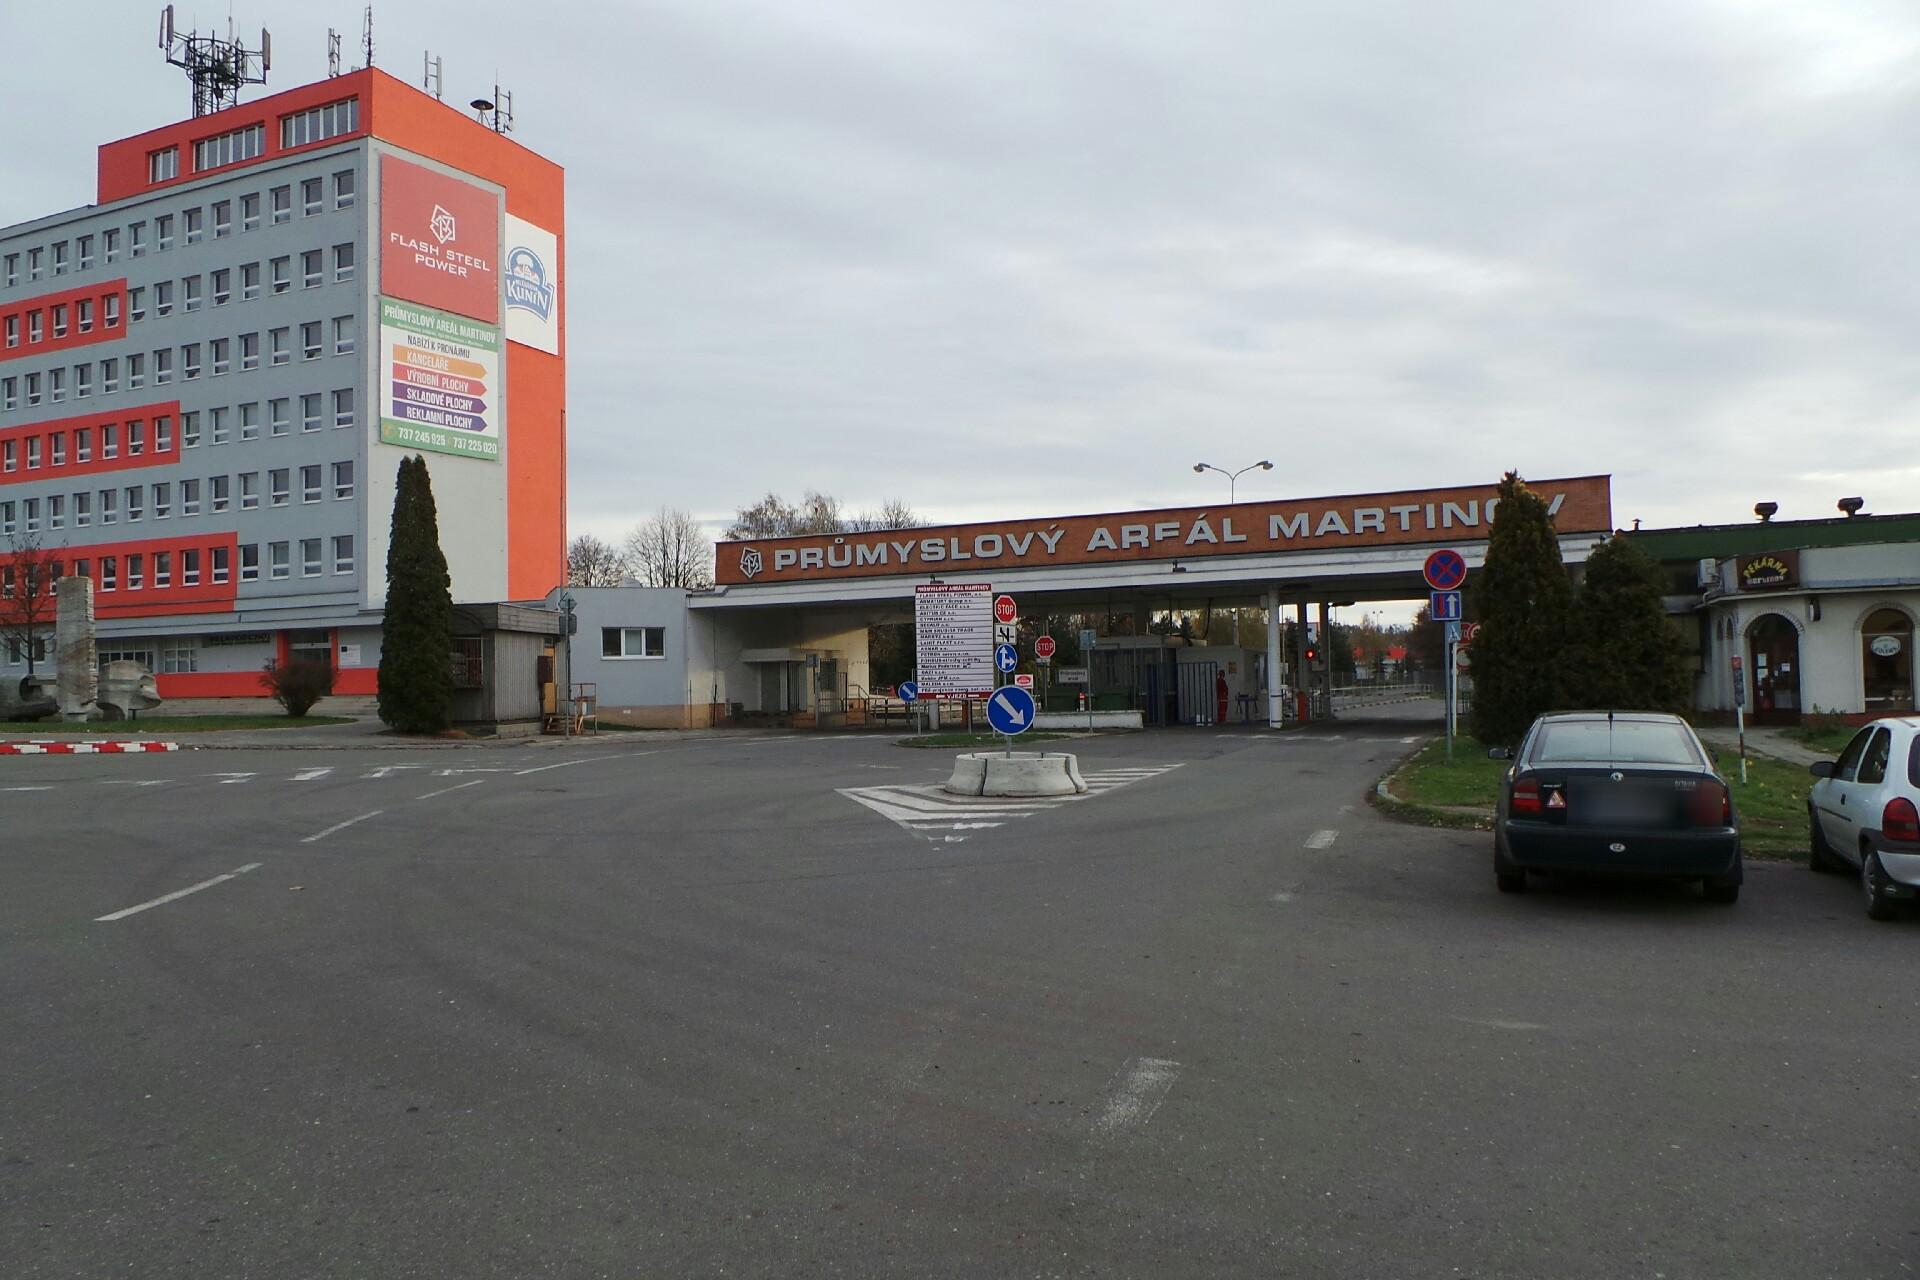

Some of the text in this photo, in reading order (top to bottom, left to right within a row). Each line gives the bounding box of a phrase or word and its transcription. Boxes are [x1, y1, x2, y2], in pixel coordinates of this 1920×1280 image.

[390, 232, 490, 272] FLASH STEEL
[415, 253, 468, 278] POWER
[384, 305, 435, 329] PRŮMYSLOVÝ
[436, 319, 459, 335] AREÁL
[460, 325, 496, 343] MARTINOV
[407, 334, 430, 350] NABÍZÍ
[431, 341, 436, 350] K
[406, 369, 469, 393] VÝROBNÍ PLOCHY
[406, 388, 473, 411] SKLADOVÉ PLOCHY
[406, 406, 473, 429] REKLAMNÍ PLOCHY
[398, 427, 413, 440] 737
[453, 437, 467, 450] 737
[774, 524, 1065, 571] PRŮMYSLOVÝ
[1269, 493, 1565, 539] MARTIN
[1743, 556, 1789, 577] PEKÁRNA
[997, 604, 1014, 616] STOP
[1037, 642, 1054, 651] STOP
